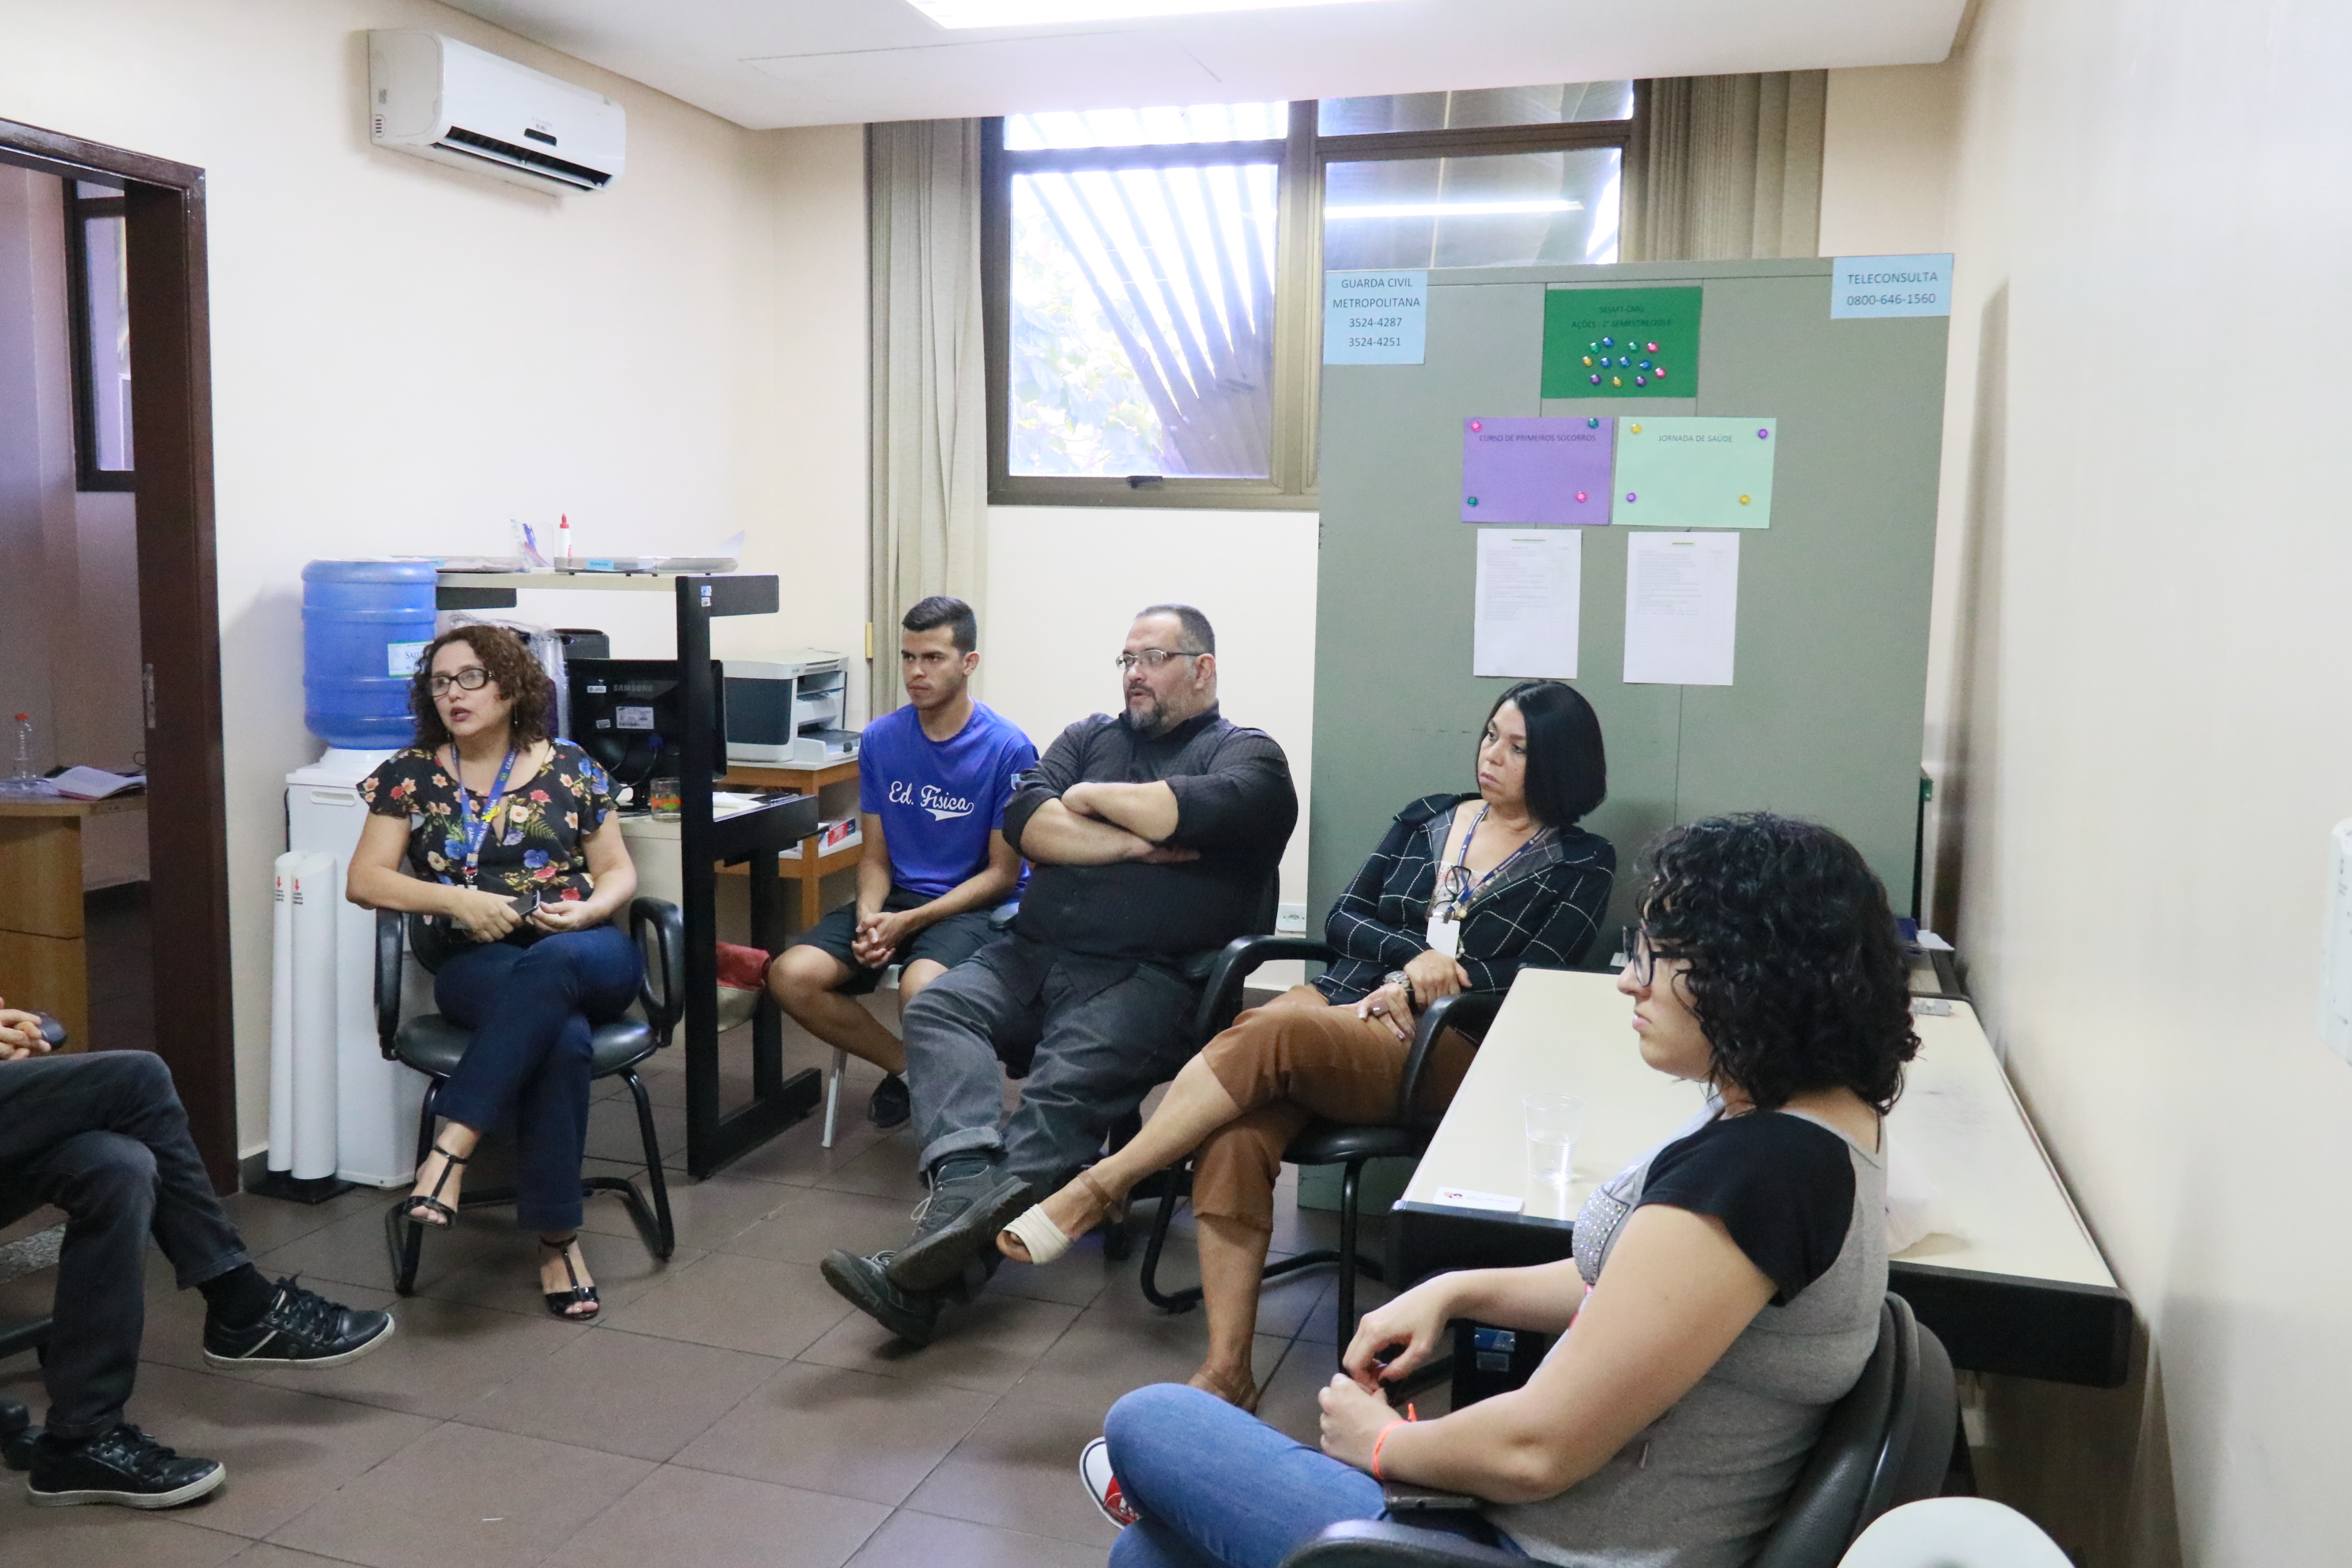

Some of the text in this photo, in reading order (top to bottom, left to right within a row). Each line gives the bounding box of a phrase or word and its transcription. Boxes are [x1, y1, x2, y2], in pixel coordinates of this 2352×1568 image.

[1341, 277, 1412, 288] GUARDA CIVIL
[1848, 272, 1938, 285] TELECONSULTA
[1332, 297, 1420, 308] METROPOLITANA
[1847, 293, 1936, 306] 0800-646-1560
[1349, 317, 1402, 328] 3524-4287
[1348, 337, 1401, 347] 3524-4251
[1707, 434, 1733, 443] SAÚDE
[888, 781, 914, 805] Ed.
